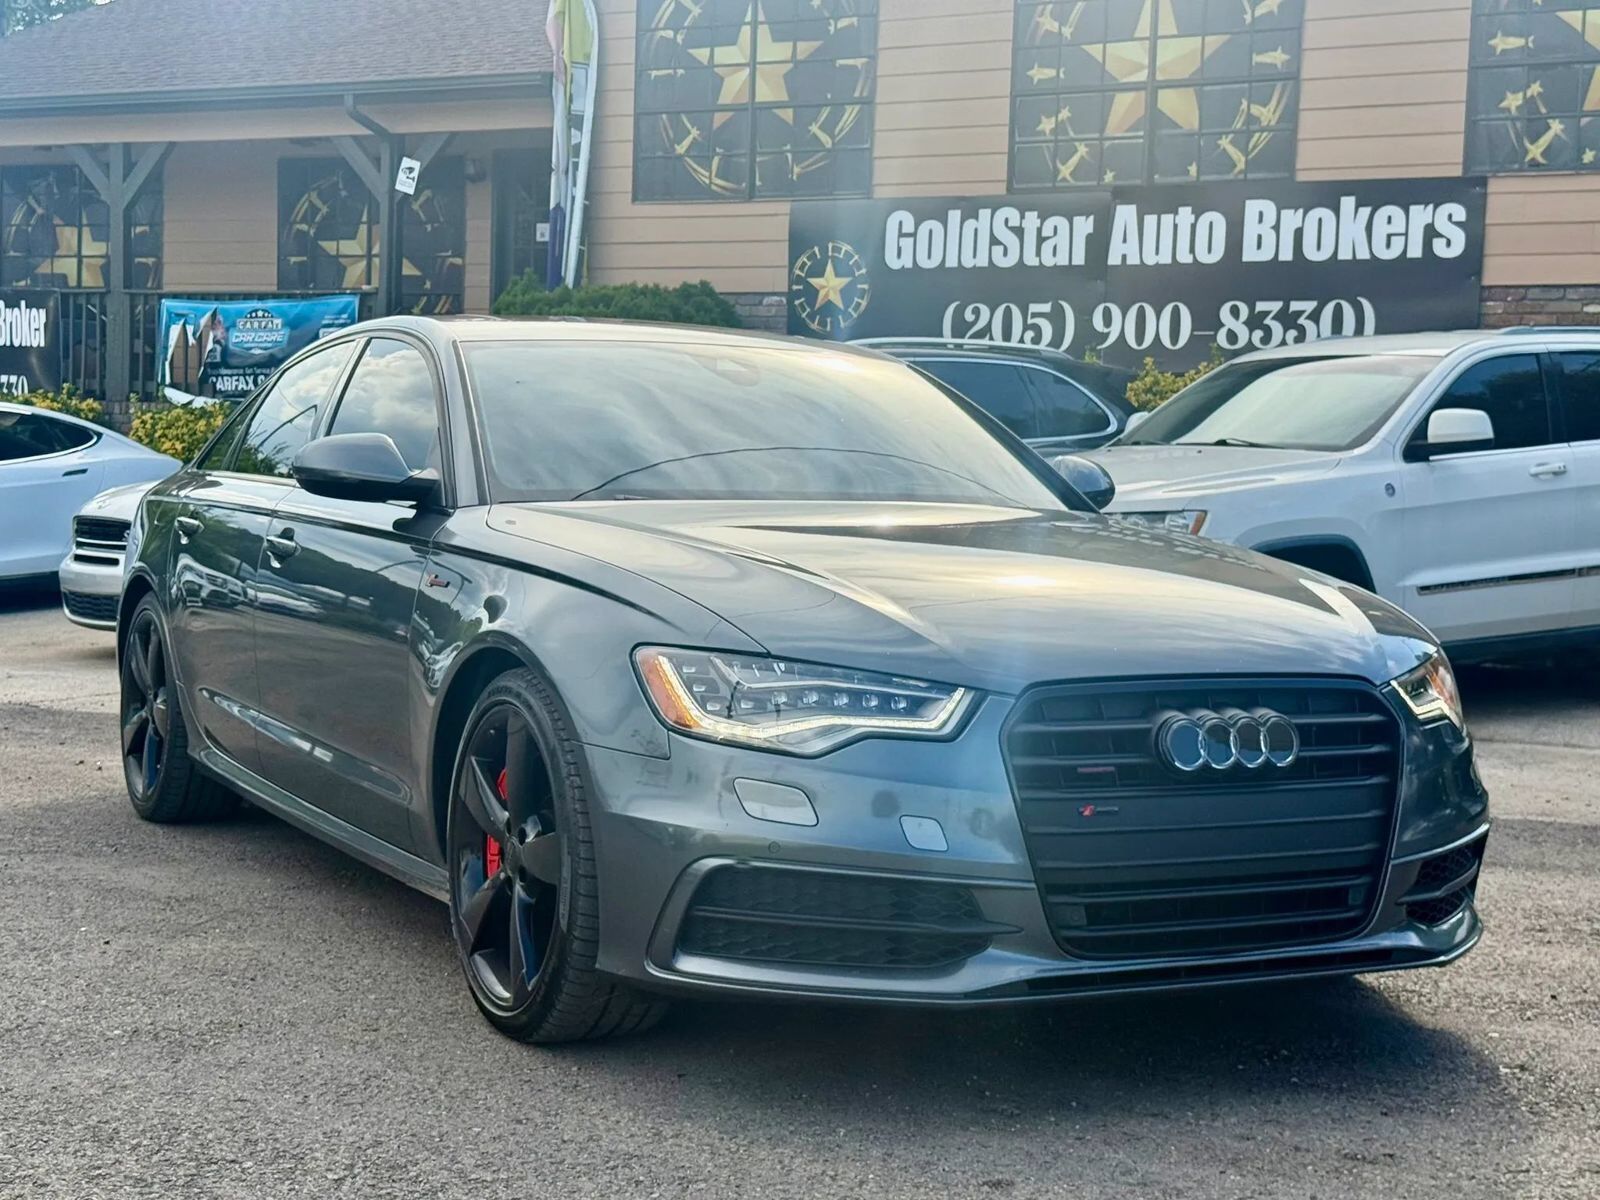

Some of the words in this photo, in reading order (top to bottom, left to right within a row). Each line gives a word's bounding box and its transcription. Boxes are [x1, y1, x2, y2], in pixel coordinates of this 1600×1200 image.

[884, 206, 1095, 270] GoldStar
[1107, 204, 1227, 266] Auto
[1242, 196, 1467, 263] Brokers
[0, 299, 47, 348] Broker
[942, 300, 1075, 351] (205)
